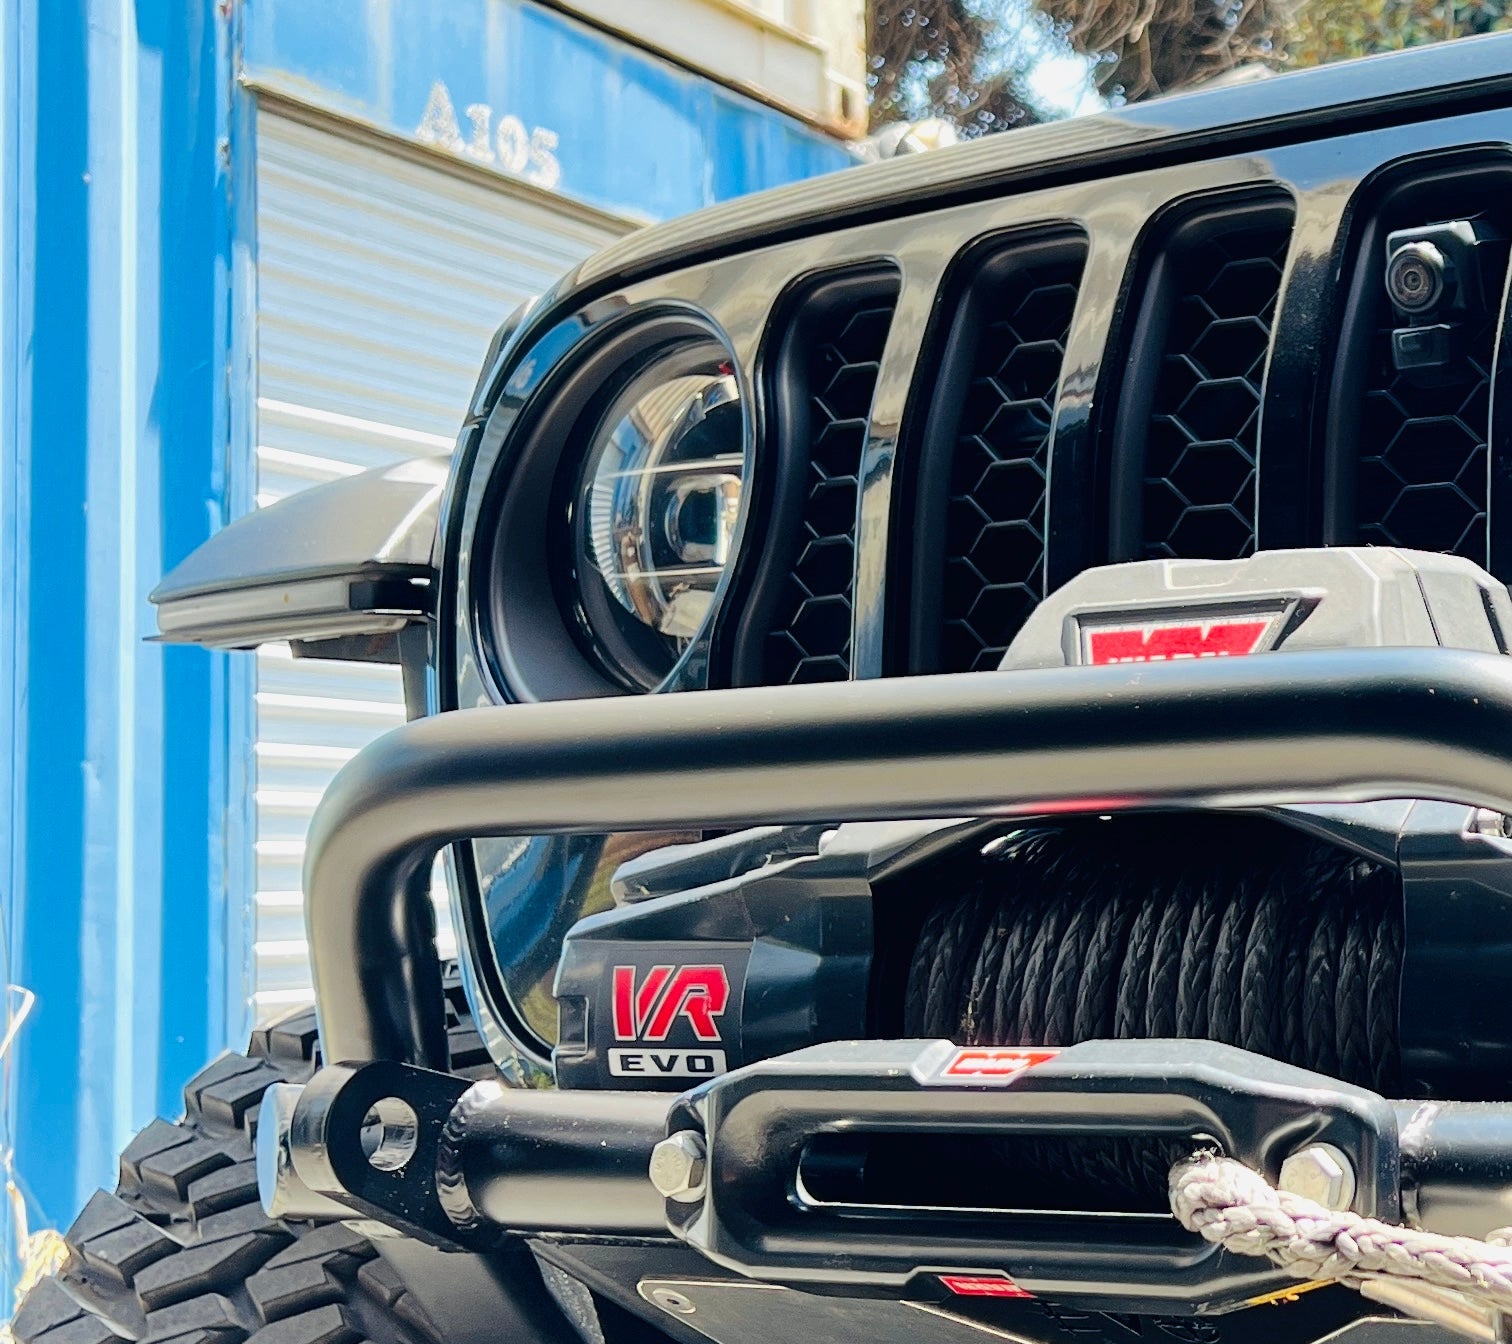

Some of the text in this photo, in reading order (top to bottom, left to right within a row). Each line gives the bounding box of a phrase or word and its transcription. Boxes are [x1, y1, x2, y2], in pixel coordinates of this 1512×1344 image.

[415, 79, 561, 189] A105
[612, 964, 731, 1042] VR
[619, 1054, 715, 1073] EVO
